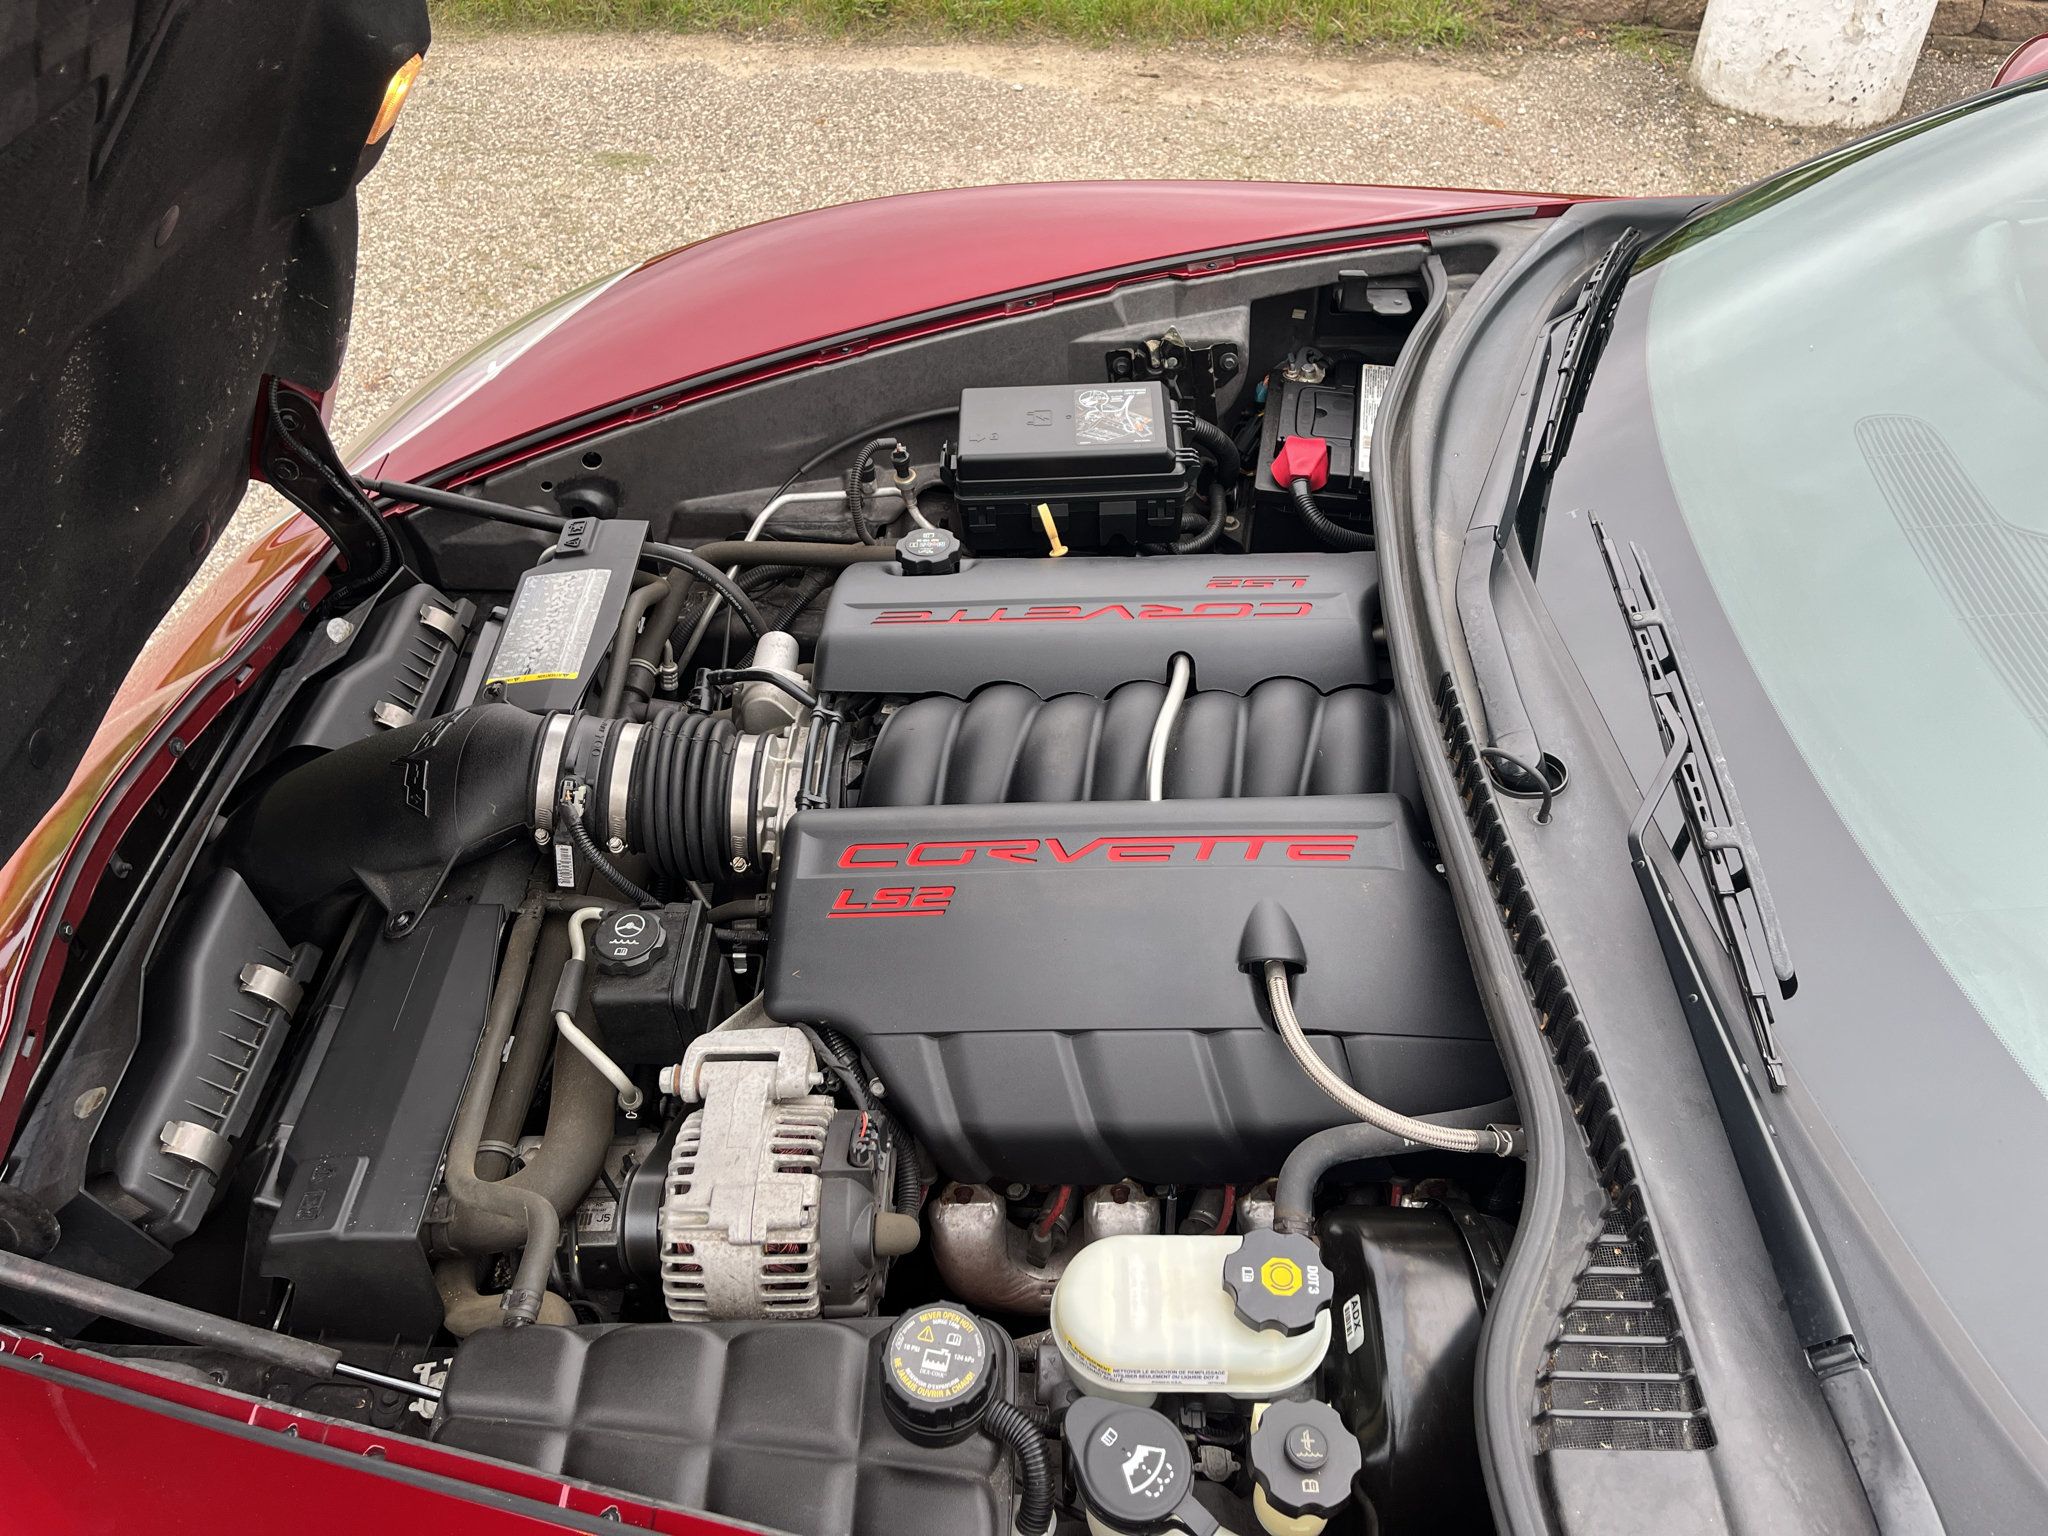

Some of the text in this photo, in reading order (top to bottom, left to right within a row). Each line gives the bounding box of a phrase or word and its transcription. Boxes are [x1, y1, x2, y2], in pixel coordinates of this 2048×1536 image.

[1206, 575, 1309, 589] LS2
[870, 602, 1314, 626] CORVETTE
[837, 834, 1359, 870] CORVETTE
[830, 885, 956, 910] LS2
[596, 1213, 611, 1223] J5
[1307, 1265, 1320, 1295] DOT 3
[919, 1311, 974, 1333] NEVER OPEN HOT!
[1351, 1300, 1362, 1332] ADX
[910, 1344, 921, 1353] PSI
[894, 1357, 903, 1369] NE
[897, 1368, 918, 1392] JAMAIS
[951, 1371, 976, 1394] CHAUD!
[917, 1387, 944, 1398] OUVRIR
